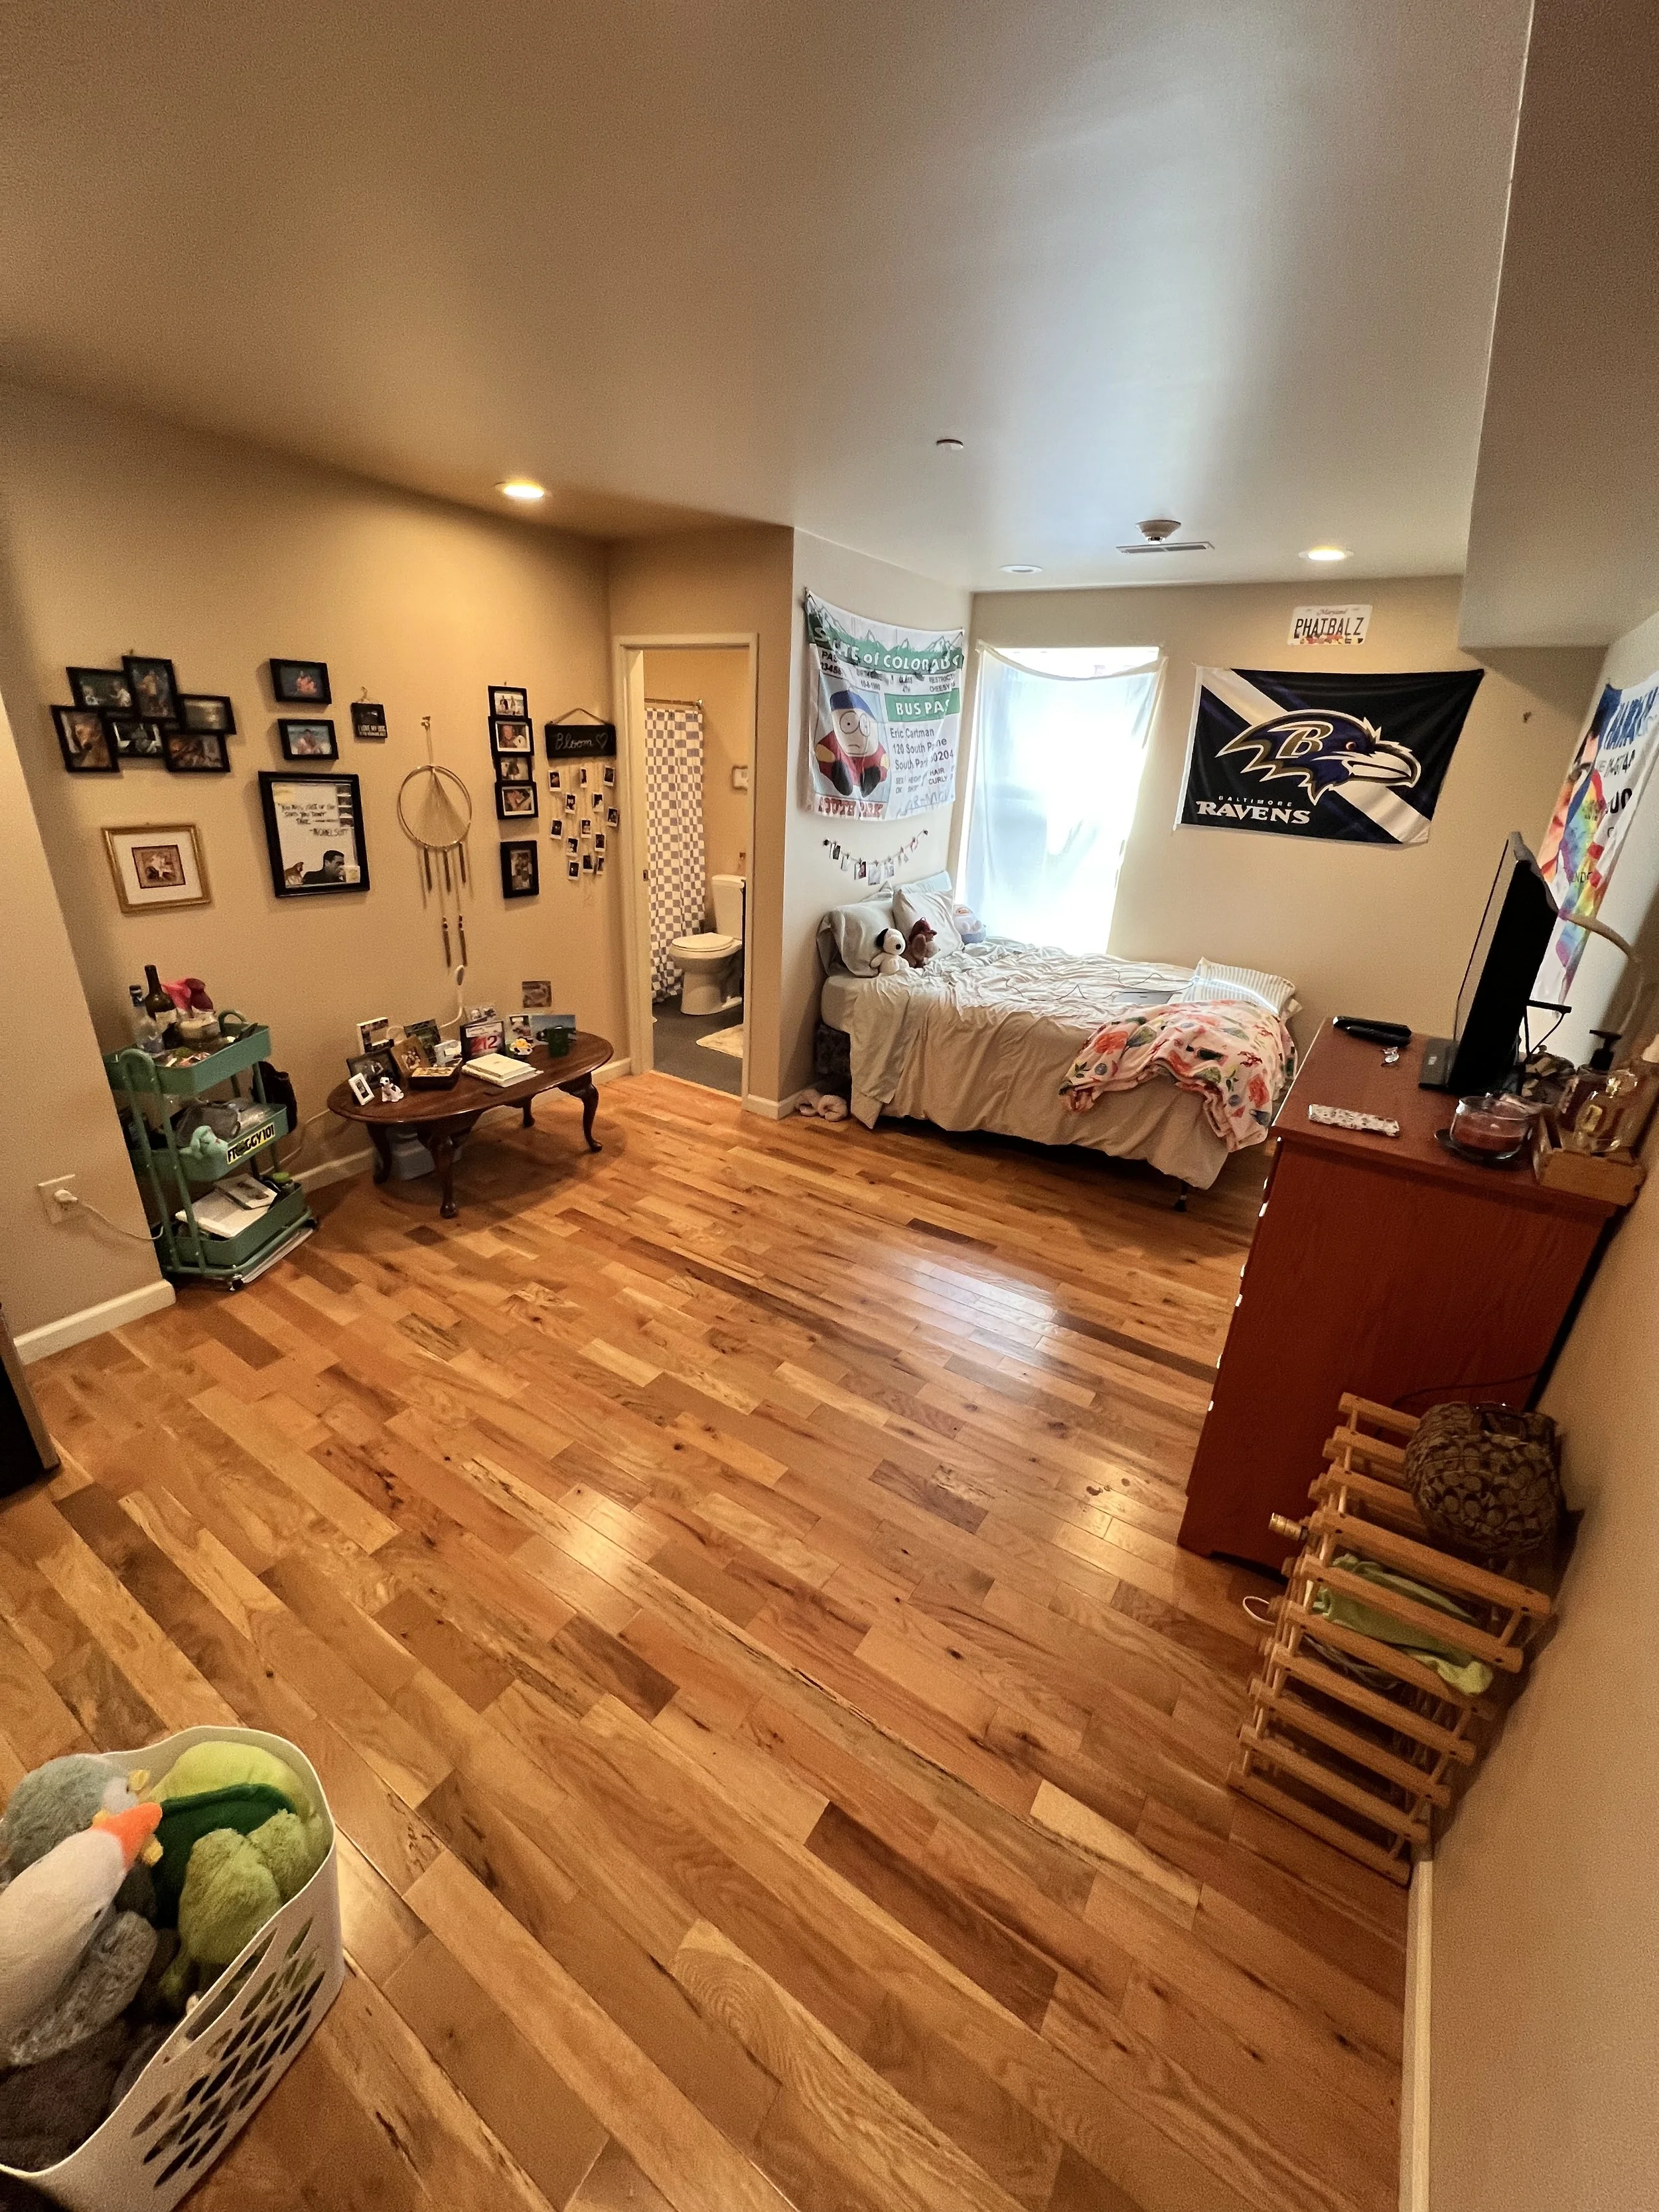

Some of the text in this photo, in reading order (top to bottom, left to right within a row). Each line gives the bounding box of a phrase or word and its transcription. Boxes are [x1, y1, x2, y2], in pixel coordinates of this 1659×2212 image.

[1294, 617, 1364, 638] PHATBALZ
[863, 652, 879, 665] of
[895, 701, 922, 715] BUS
[890, 727, 935, 739] Eric Cartman
[555, 733, 594, 750] Bloom
[893, 743, 904, 755] 120
[906, 742, 926, 754] South
[895, 759, 914, 772] South
[1219, 796, 1293, 807] BALTIMORE
[1196, 800, 1312, 824] RAVENS
